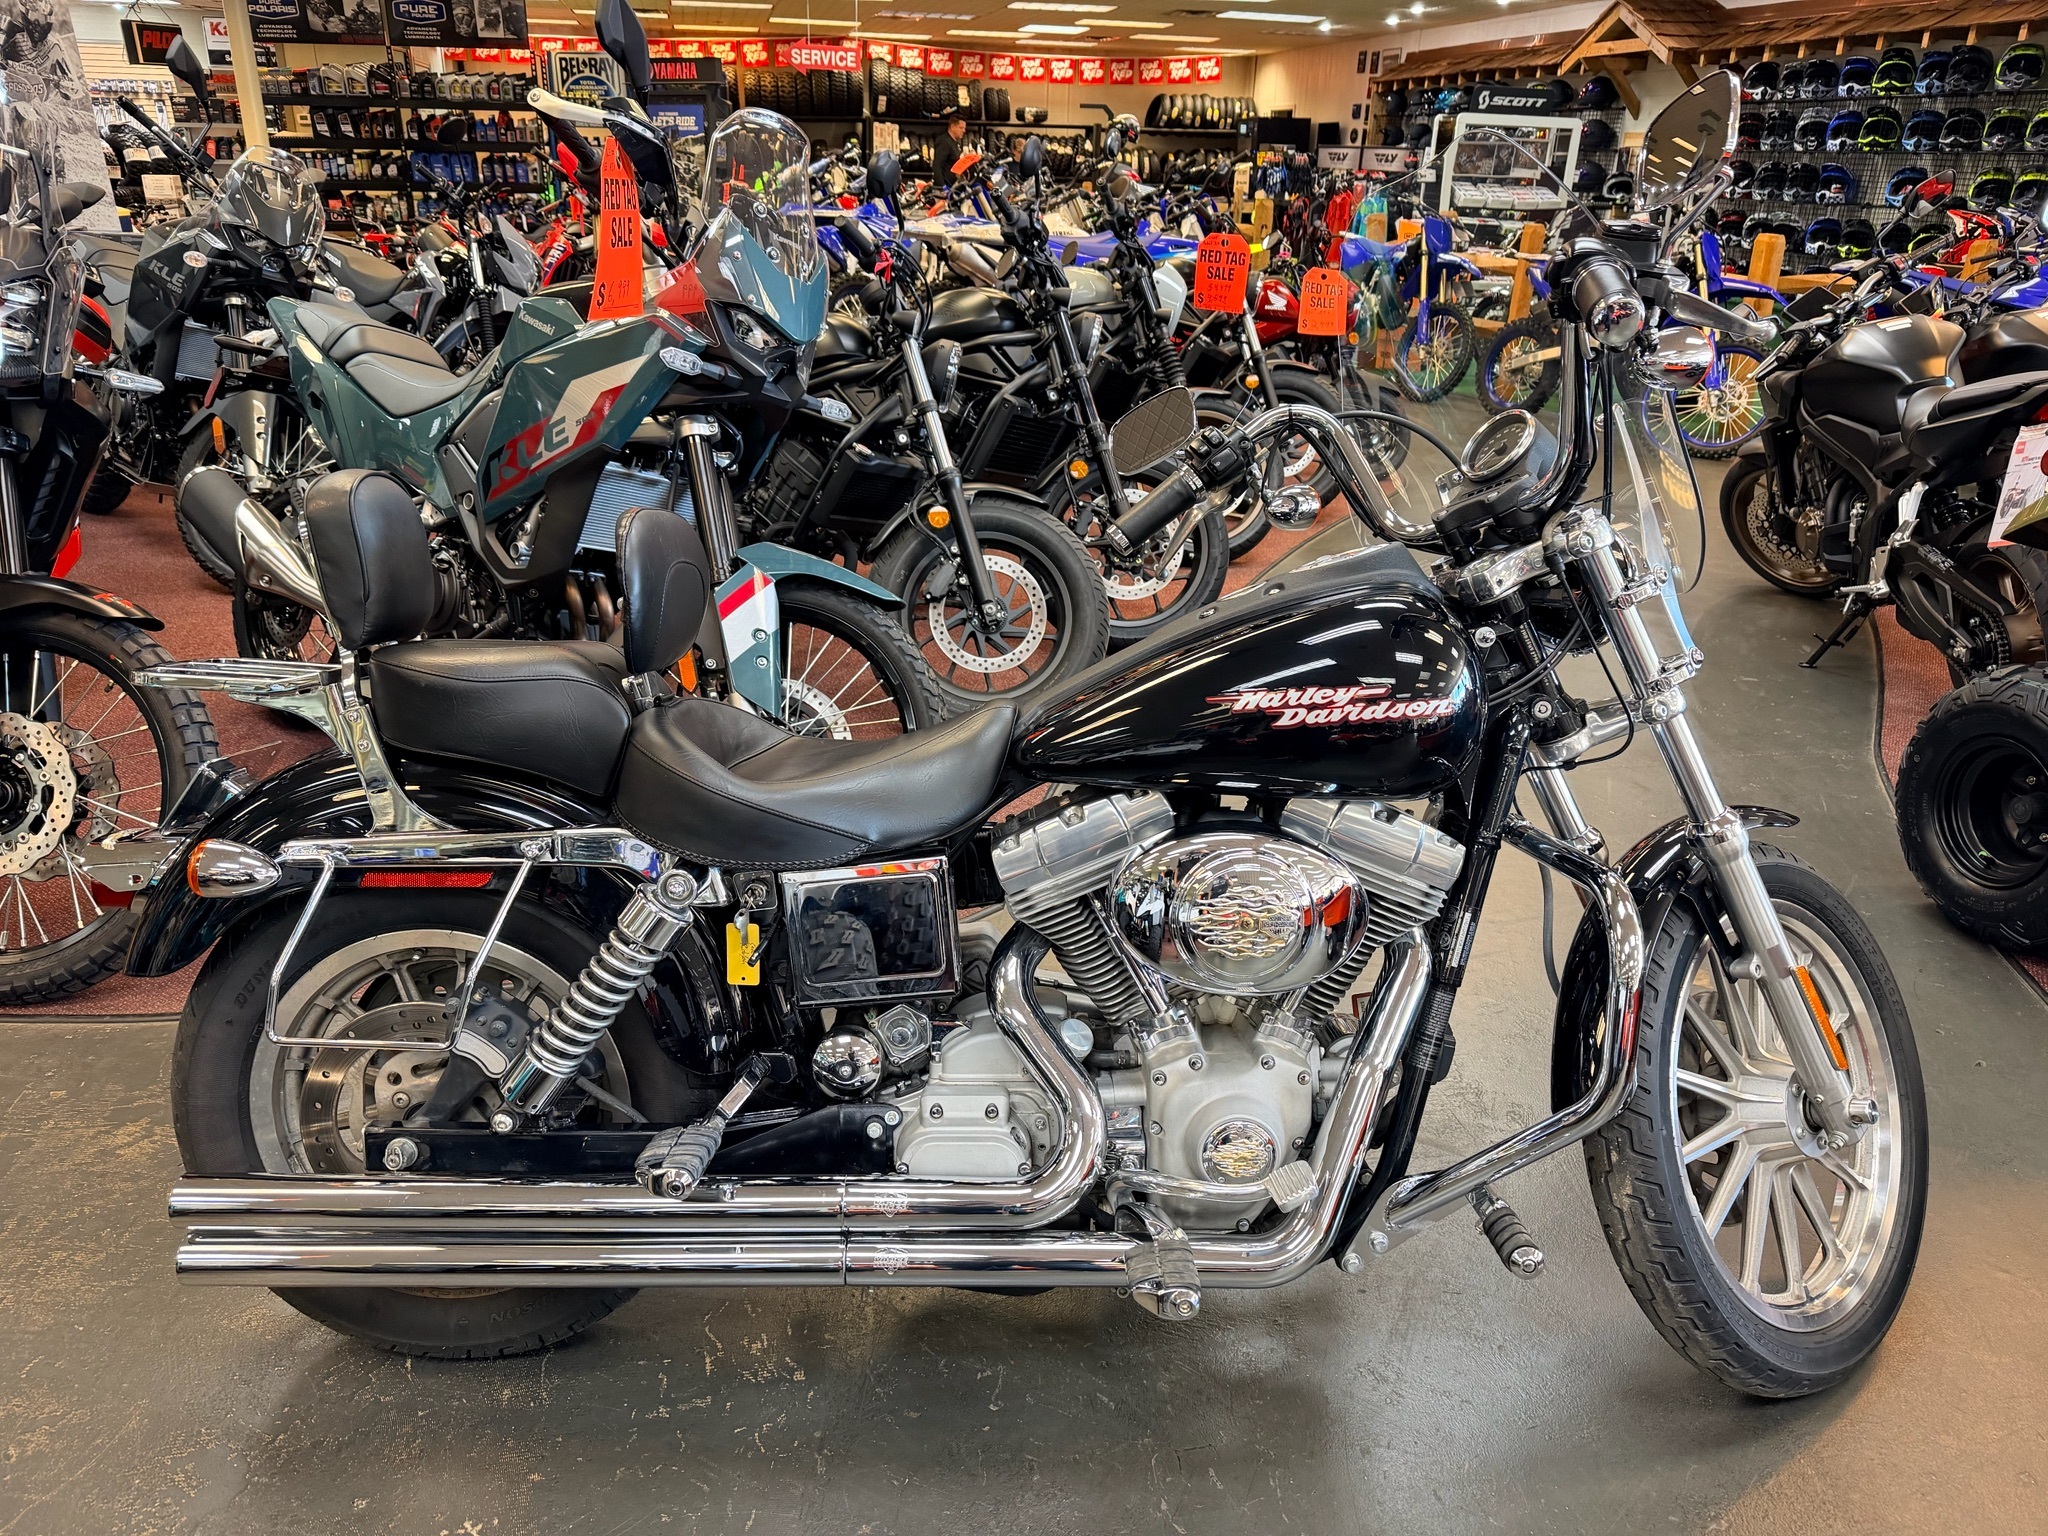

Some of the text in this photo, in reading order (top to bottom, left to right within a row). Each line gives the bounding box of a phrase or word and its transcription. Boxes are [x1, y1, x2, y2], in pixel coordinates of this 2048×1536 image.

[248, 5, 297, 14] POLARIS
[399, 4, 438, 14] PURE
[142, 30, 182, 49] PILO
[541, 40, 563, 51] RIDE
[711, 42, 731, 52] RIDE
[743, 42, 762, 52] RIDE
[870, 43, 888, 52] RIDE
[899, 46, 919, 57] RIDE
[746, 51, 768, 63] RED
[791, 47, 857, 68] SERVICE
[901, 55, 923, 68] RED
[929, 51, 949, 62] RIDE
[960, 52, 981, 63] RIDE
[991, 56, 1011, 67] RIDE
[931, 60, 953, 72] RED
[962, 62, 984, 74] RED
[1021, 58, 1041, 69] RIDE
[1051, 59, 1071, 69] RIDE
[1081, 59, 1101, 70] RIDE
[1110, 59, 1130, 70] RIDE
[1140, 60, 1160, 70] RIDE
[1170, 59, 1189, 69] RIDE
[1199, 58, 1218, 69] RIDE
[654, 61, 698, 80] YAMAHA
[993, 64, 1014, 77] RED
[1023, 67, 1045, 79] RED
[1052, 68, 1074, 80] RED
[1083, 68, 1104, 81] RED
[1112, 68, 1134, 81] RED
[1141, 68, 1162, 81] RED
[1171, 67, 1192, 80] RED
[1200, 66, 1221, 79] RED
[1490, 96, 1547, 108] SCOTT
[652, 116, 696, 127] LET'S RIDE
[604, 178, 638, 211] RED TAG
[611, 217, 633, 249] SALE
[1200, 249, 1247, 266] RED TAG
[148, 259, 186, 288] KLE
[1206, 266, 1235, 282] SALE
[166, 282, 183, 295] 500
[1304, 280, 1343, 296] RED TAG
[597, 282, 606, 309] $
[1197, 292, 1205, 304] $
[1265, 304, 1287, 312] HONDA
[1309, 297, 1335, 309] SALE
[518, 310, 556, 336] Kawasaki
[1301, 319, 1308, 330] $
[489, 415, 570, 488] KLE
[1231, 685, 1391, 712] Harley
[1268, 698, 1454, 730] Davidson
